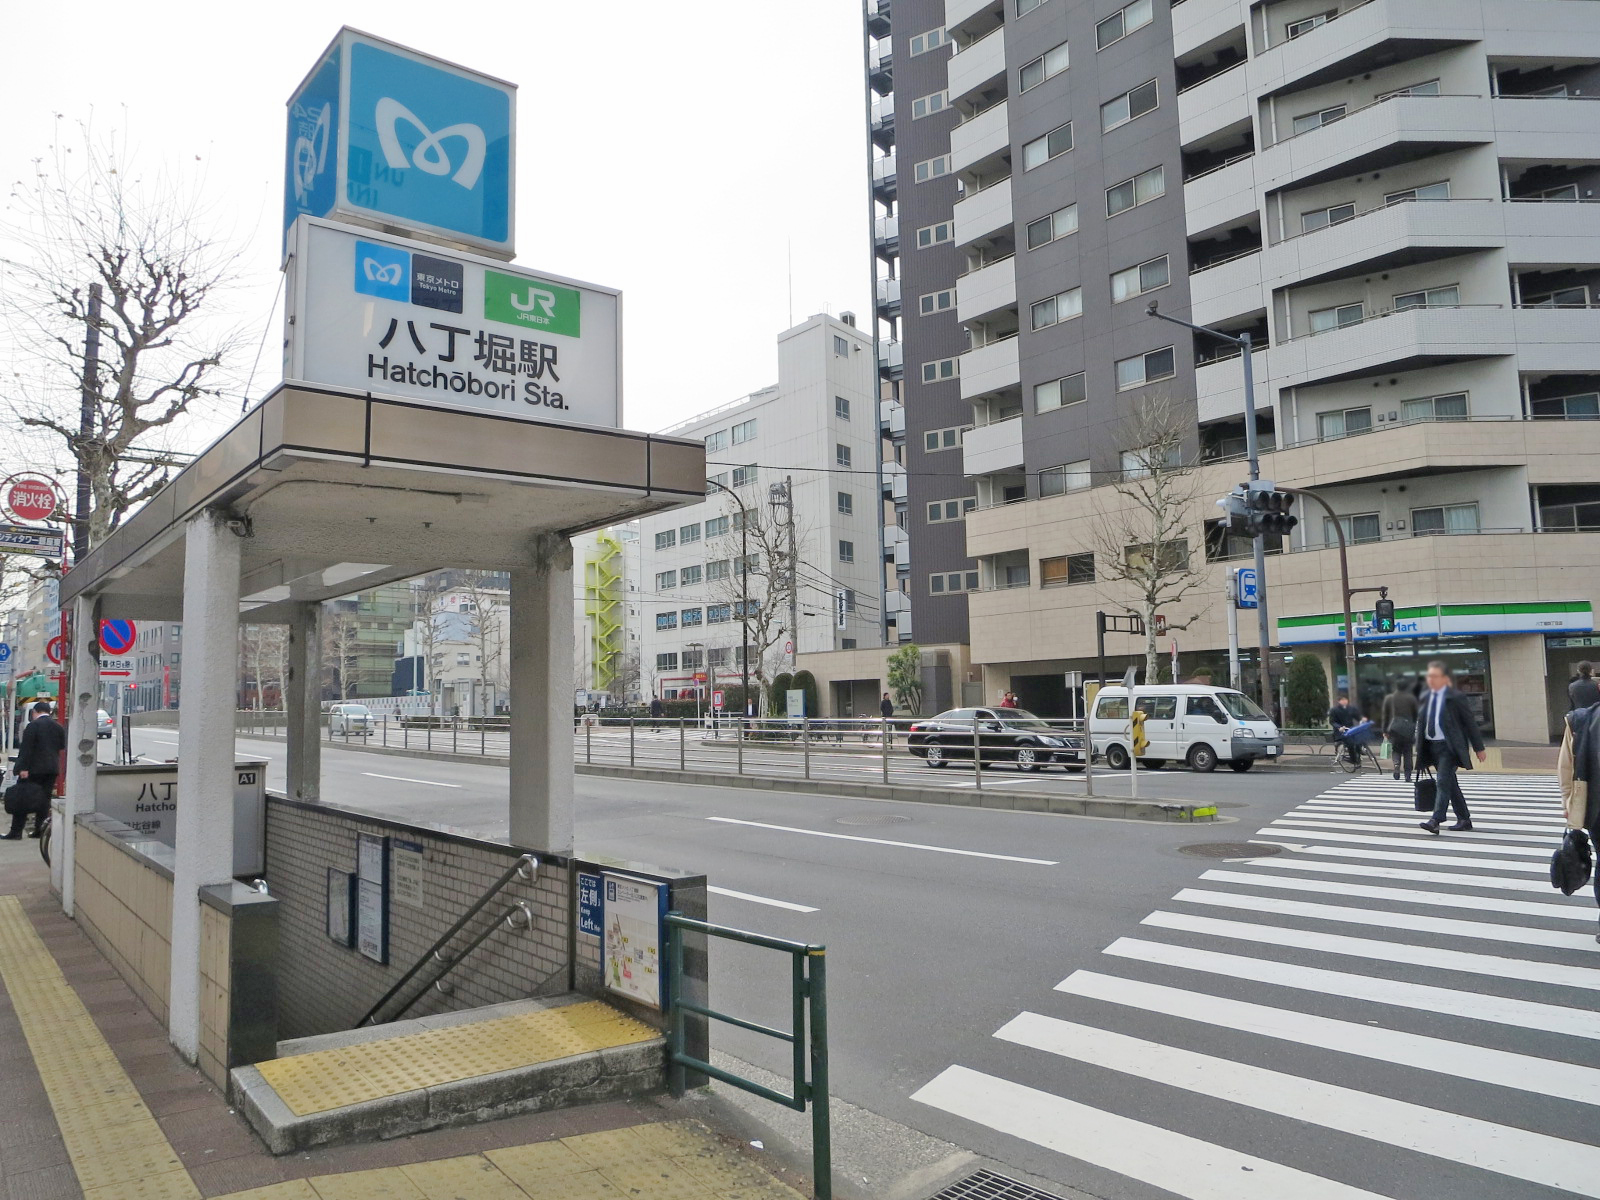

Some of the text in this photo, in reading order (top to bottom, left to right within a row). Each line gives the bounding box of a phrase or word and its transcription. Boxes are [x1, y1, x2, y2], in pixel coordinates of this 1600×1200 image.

[416, 272, 459, 289] 東京メトロ
[419, 282, 457, 296] Tokyo Metro
[510, 286, 556, 318] JR
[516, 312, 550, 325] JR東日本
[378, 317, 560, 383] 八丁堀駅
[368, 353, 569, 411] Hatchōbori Sta.
[12, 490, 53, 510] 消火栓
[239, 774, 255, 784] A1
[580, 877, 597, 888] ここでは
[580, 906, 591, 917] Keep
[580, 916, 594, 931] Left
